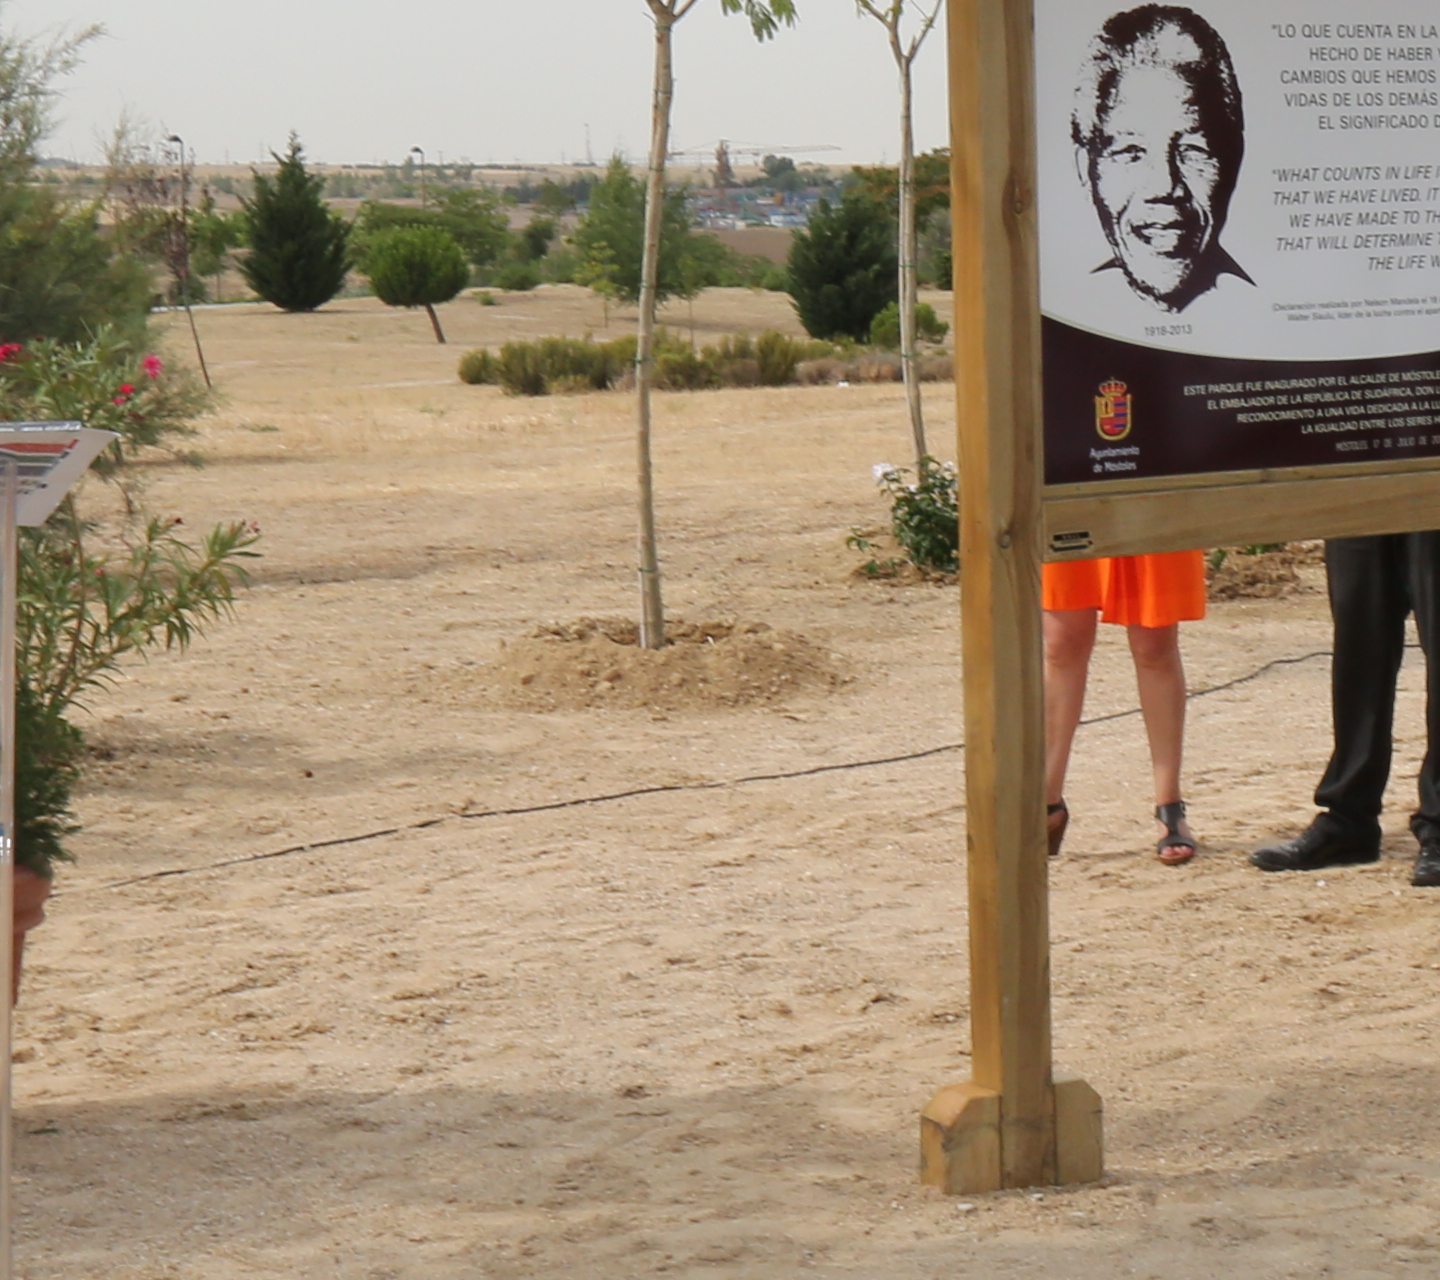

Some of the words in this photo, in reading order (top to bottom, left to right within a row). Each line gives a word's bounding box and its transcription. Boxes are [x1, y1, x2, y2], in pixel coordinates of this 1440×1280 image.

[1301, 24, 1332, 38] QUE
[1335, 24, 1393, 39] CUENTA
[1396, 25, 1416, 39] EN
[1420, 25, 1438, 39] LA
[1309, 47, 1359, 61] HECHO
[1363, 47, 1382, 61] DE
[1387, 47, 1433, 61] HABER
[1280, 70, 1347, 84] CAMBIOS
[1351, 70, 1382, 84] QUE
[1386, 70, 1437, 84] HEMOS
[1283, 93, 1328, 106] VIDAS
[1333, 93, 1351, 106] DE
[1356, 93, 1384, 106] LOS
[1388, 89, 1438, 106] DEMÁS
[1318, 116, 1335, 130] EL
[1339, 115, 1429, 129] SIGNIFICADO
[1324, 167, 1381, 181] COUNTS
[1385, 166, 1401, 180] IN
[1404, 166, 1432, 179] LIFE
[1273, 191, 1310, 205] THAT
[1314, 190, 1336, 204] WE
[1340, 190, 1377, 203] HAVE
[1381, 188, 1420, 202] LIVED.
[1427, 188, 1439, 201] IT
[1290, 214, 1311, 228] WE
[1315, 213, 1352, 227] HAVE
[1357, 211, 1398, 225] MADE
[1404, 211, 1420, 224] TO
[1277, 237, 1312, 251] THAT
[1318, 236, 1348, 249] WILL
[1354, 233, 1433, 248] DETERMINE
[1368, 256, 1394, 270] THE
[1398, 255, 1426, 269] LIFE
[1144, 324, 1192, 337] 1918-2013
[1184, 386, 1206, 395] ESTE
[1208, 383, 1243, 394] PARQUE
[1246, 382, 1262, 391] FUE
[1318, 377, 1336, 387] POR
[1338, 376, 1347, 386] EL
[1350, 373, 1386, 384] ALCALDE
[1389, 372, 1400, 382] DE
[1208, 400, 1218, 410] EL
[1220, 396, 1274, 409] EMBAJADOR
[1277, 395, 1288, 405] DE
[1290, 394, 1302, 404] LA
[1352, 390, 1362, 400] DE
[1415, 386, 1434, 395] DON
[1237, 409, 1315, 422] RECONOCIMIENTO
[1317, 408, 1323, 417] A
[1325, 407, 1344, 417] UNA
[1345, 406, 1365, 415] VIDA
[1367, 403, 1409, 414] DEDICADA
[1411, 402, 1417, 410] A
[1419, 401, 1430, 410] LA
[1302, 425, 1313, 434] LA
[1315, 421, 1358, 432] IGUALDAD
[1360, 419, 1386, 429] ENTRE
[1388, 417, 1405, 427] LOS
[1407, 416, 1432, 426] SERES
